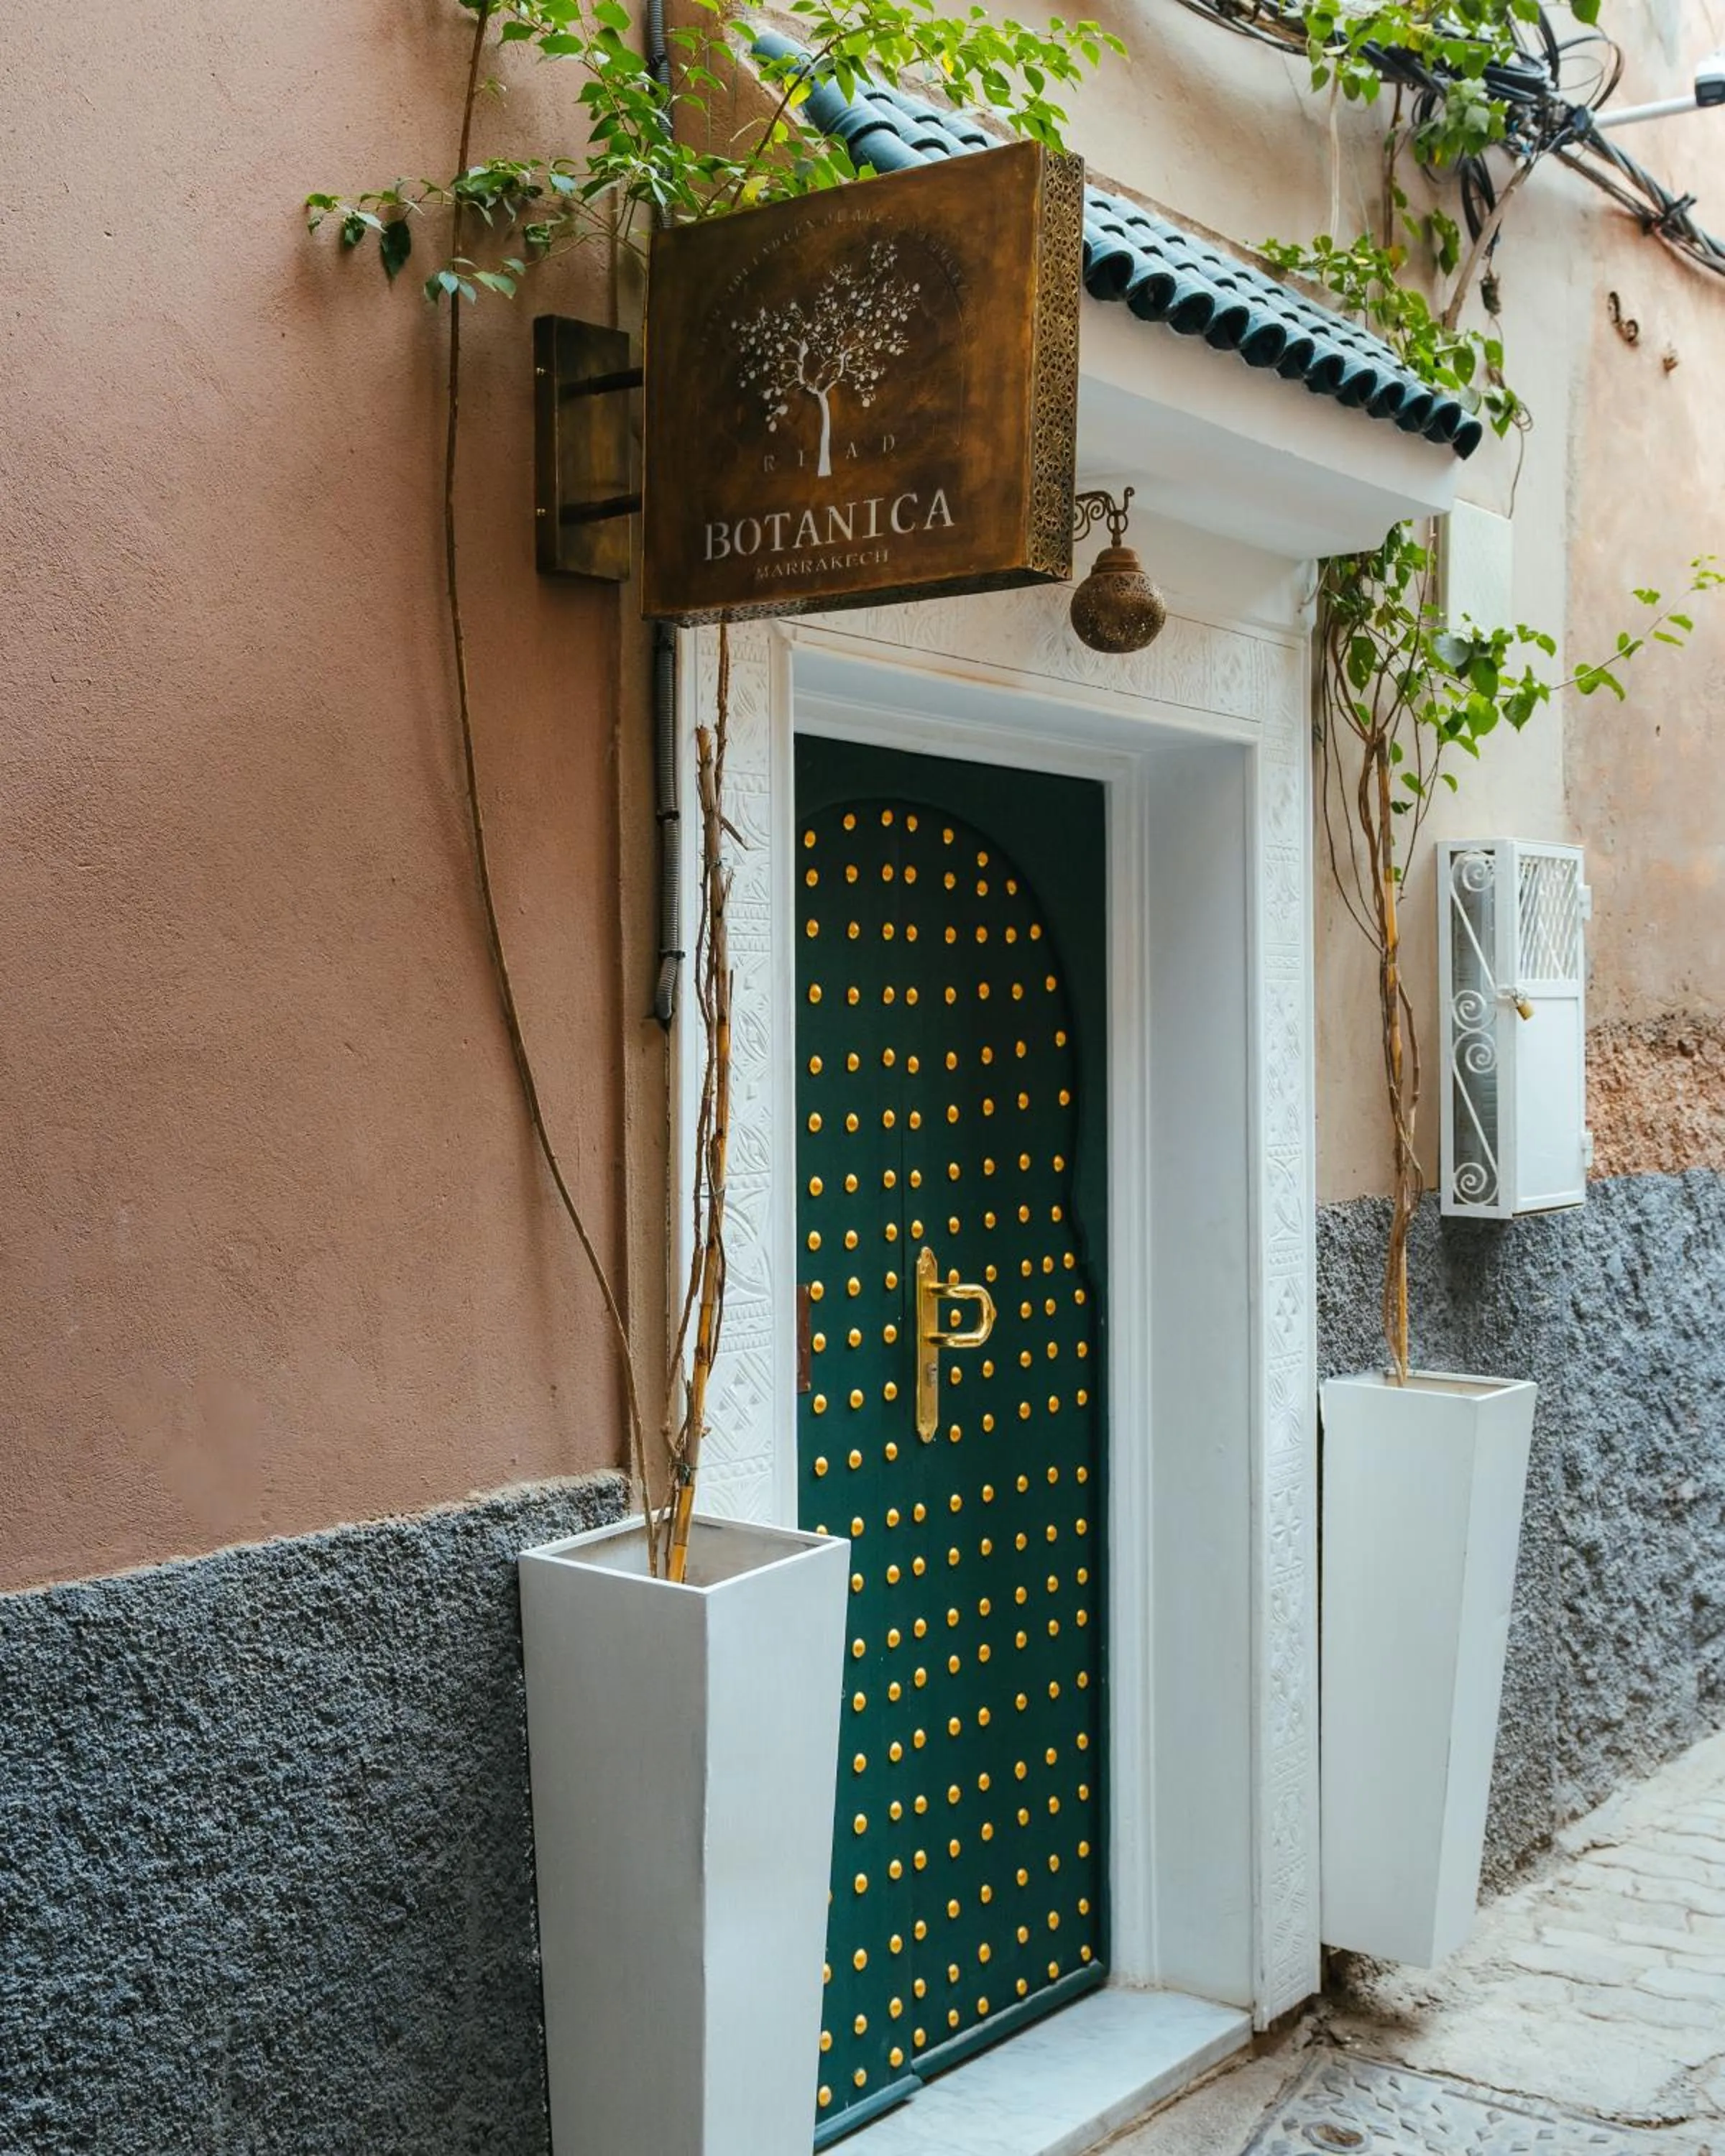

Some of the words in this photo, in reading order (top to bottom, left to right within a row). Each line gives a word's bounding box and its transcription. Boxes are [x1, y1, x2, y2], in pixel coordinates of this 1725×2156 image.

[764, 434, 895, 472] RIAD
[704, 488, 955, 561] BOTANICA
[756, 548, 889, 579] MARRAKECH
